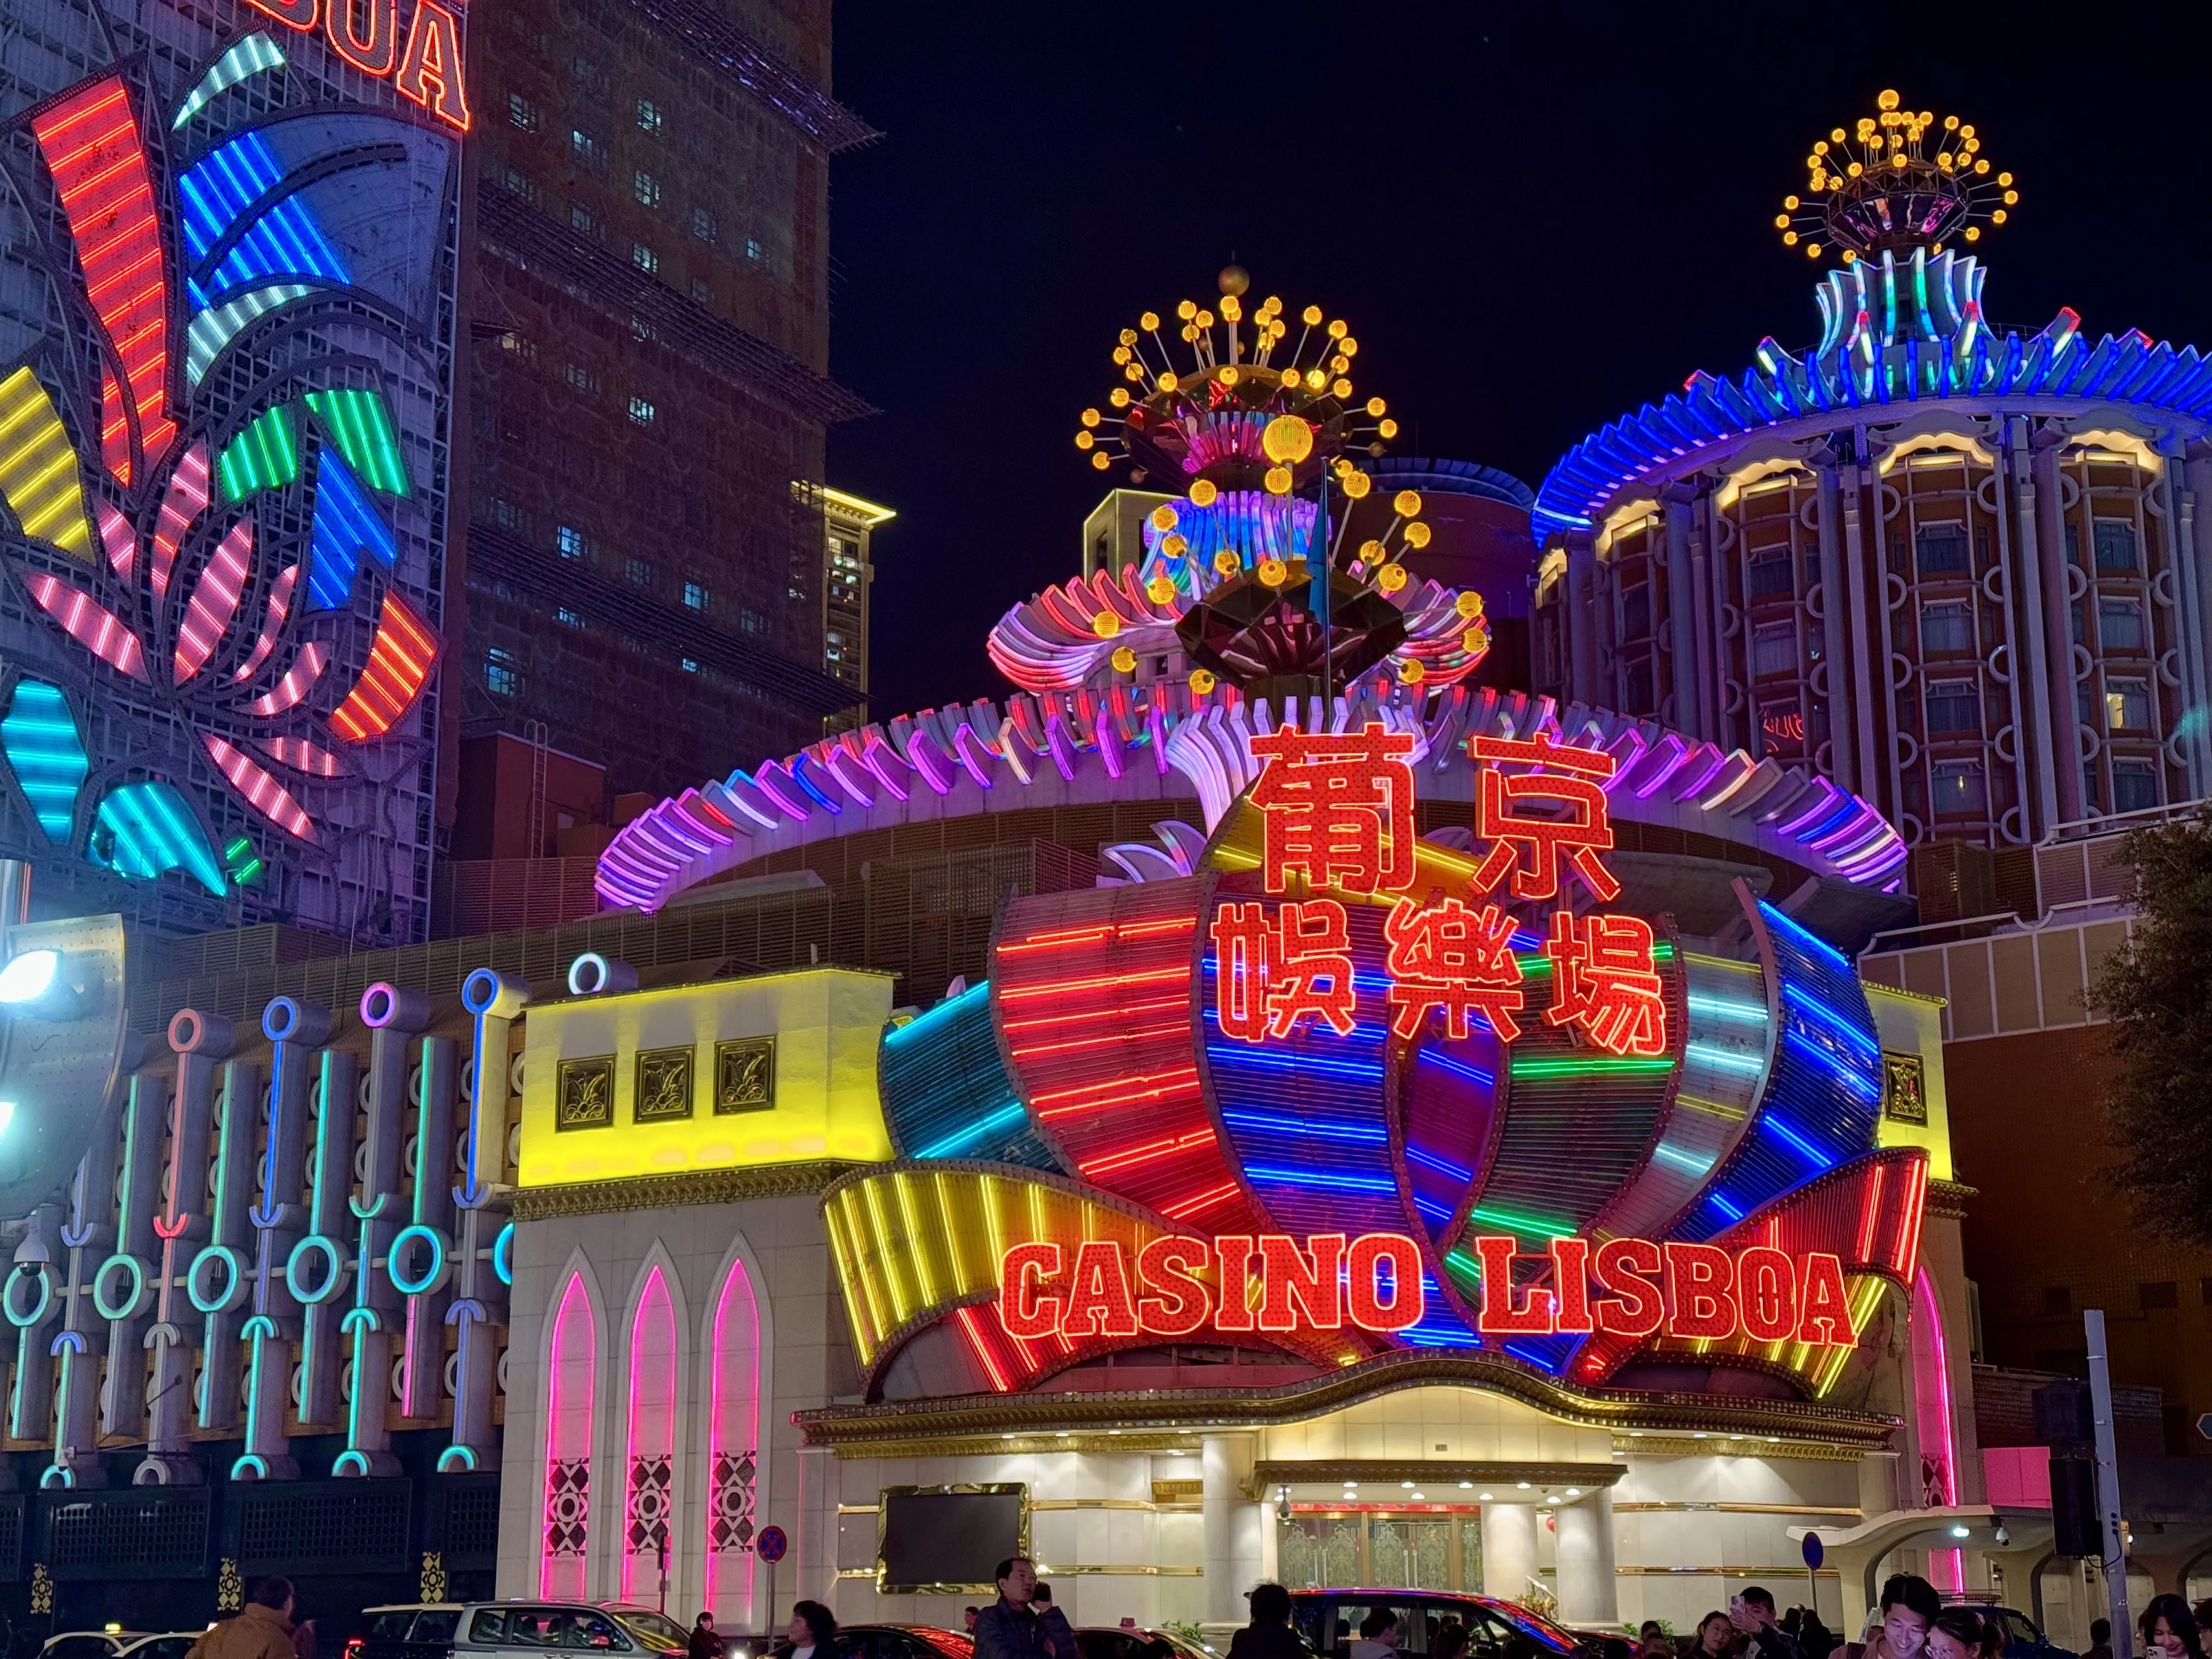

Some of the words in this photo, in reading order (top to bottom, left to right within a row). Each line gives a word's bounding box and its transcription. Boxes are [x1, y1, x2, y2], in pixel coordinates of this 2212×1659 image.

[246, 0, 470, 131] OA
[1246, 721, 1622, 903] 葡京
[999, 1232, 1425, 1340] CASINO
[1474, 1235, 1859, 1350] LISBOA
